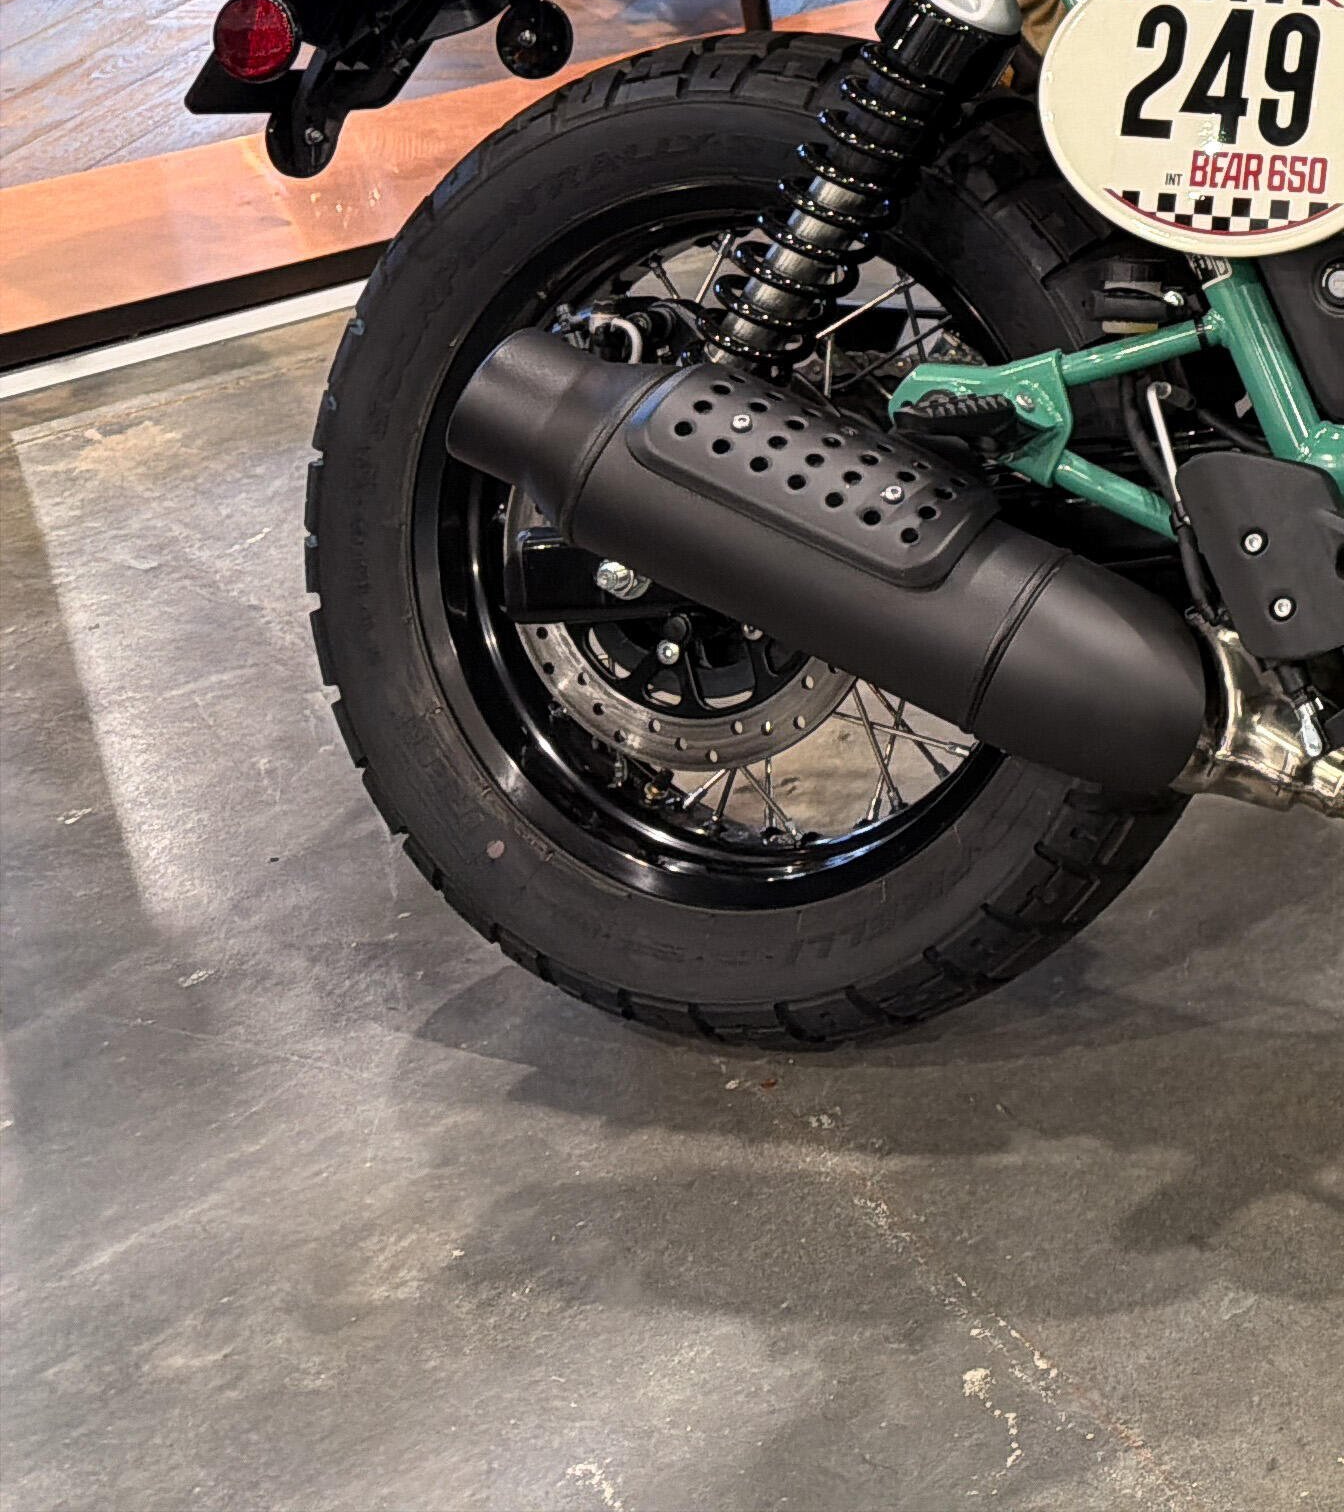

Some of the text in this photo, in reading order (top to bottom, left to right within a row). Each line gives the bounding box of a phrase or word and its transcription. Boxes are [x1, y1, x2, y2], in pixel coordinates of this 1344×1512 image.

[1120, 4, 1321, 146] 249
[1165, 150, 1328, 194] INT BEAR 650
